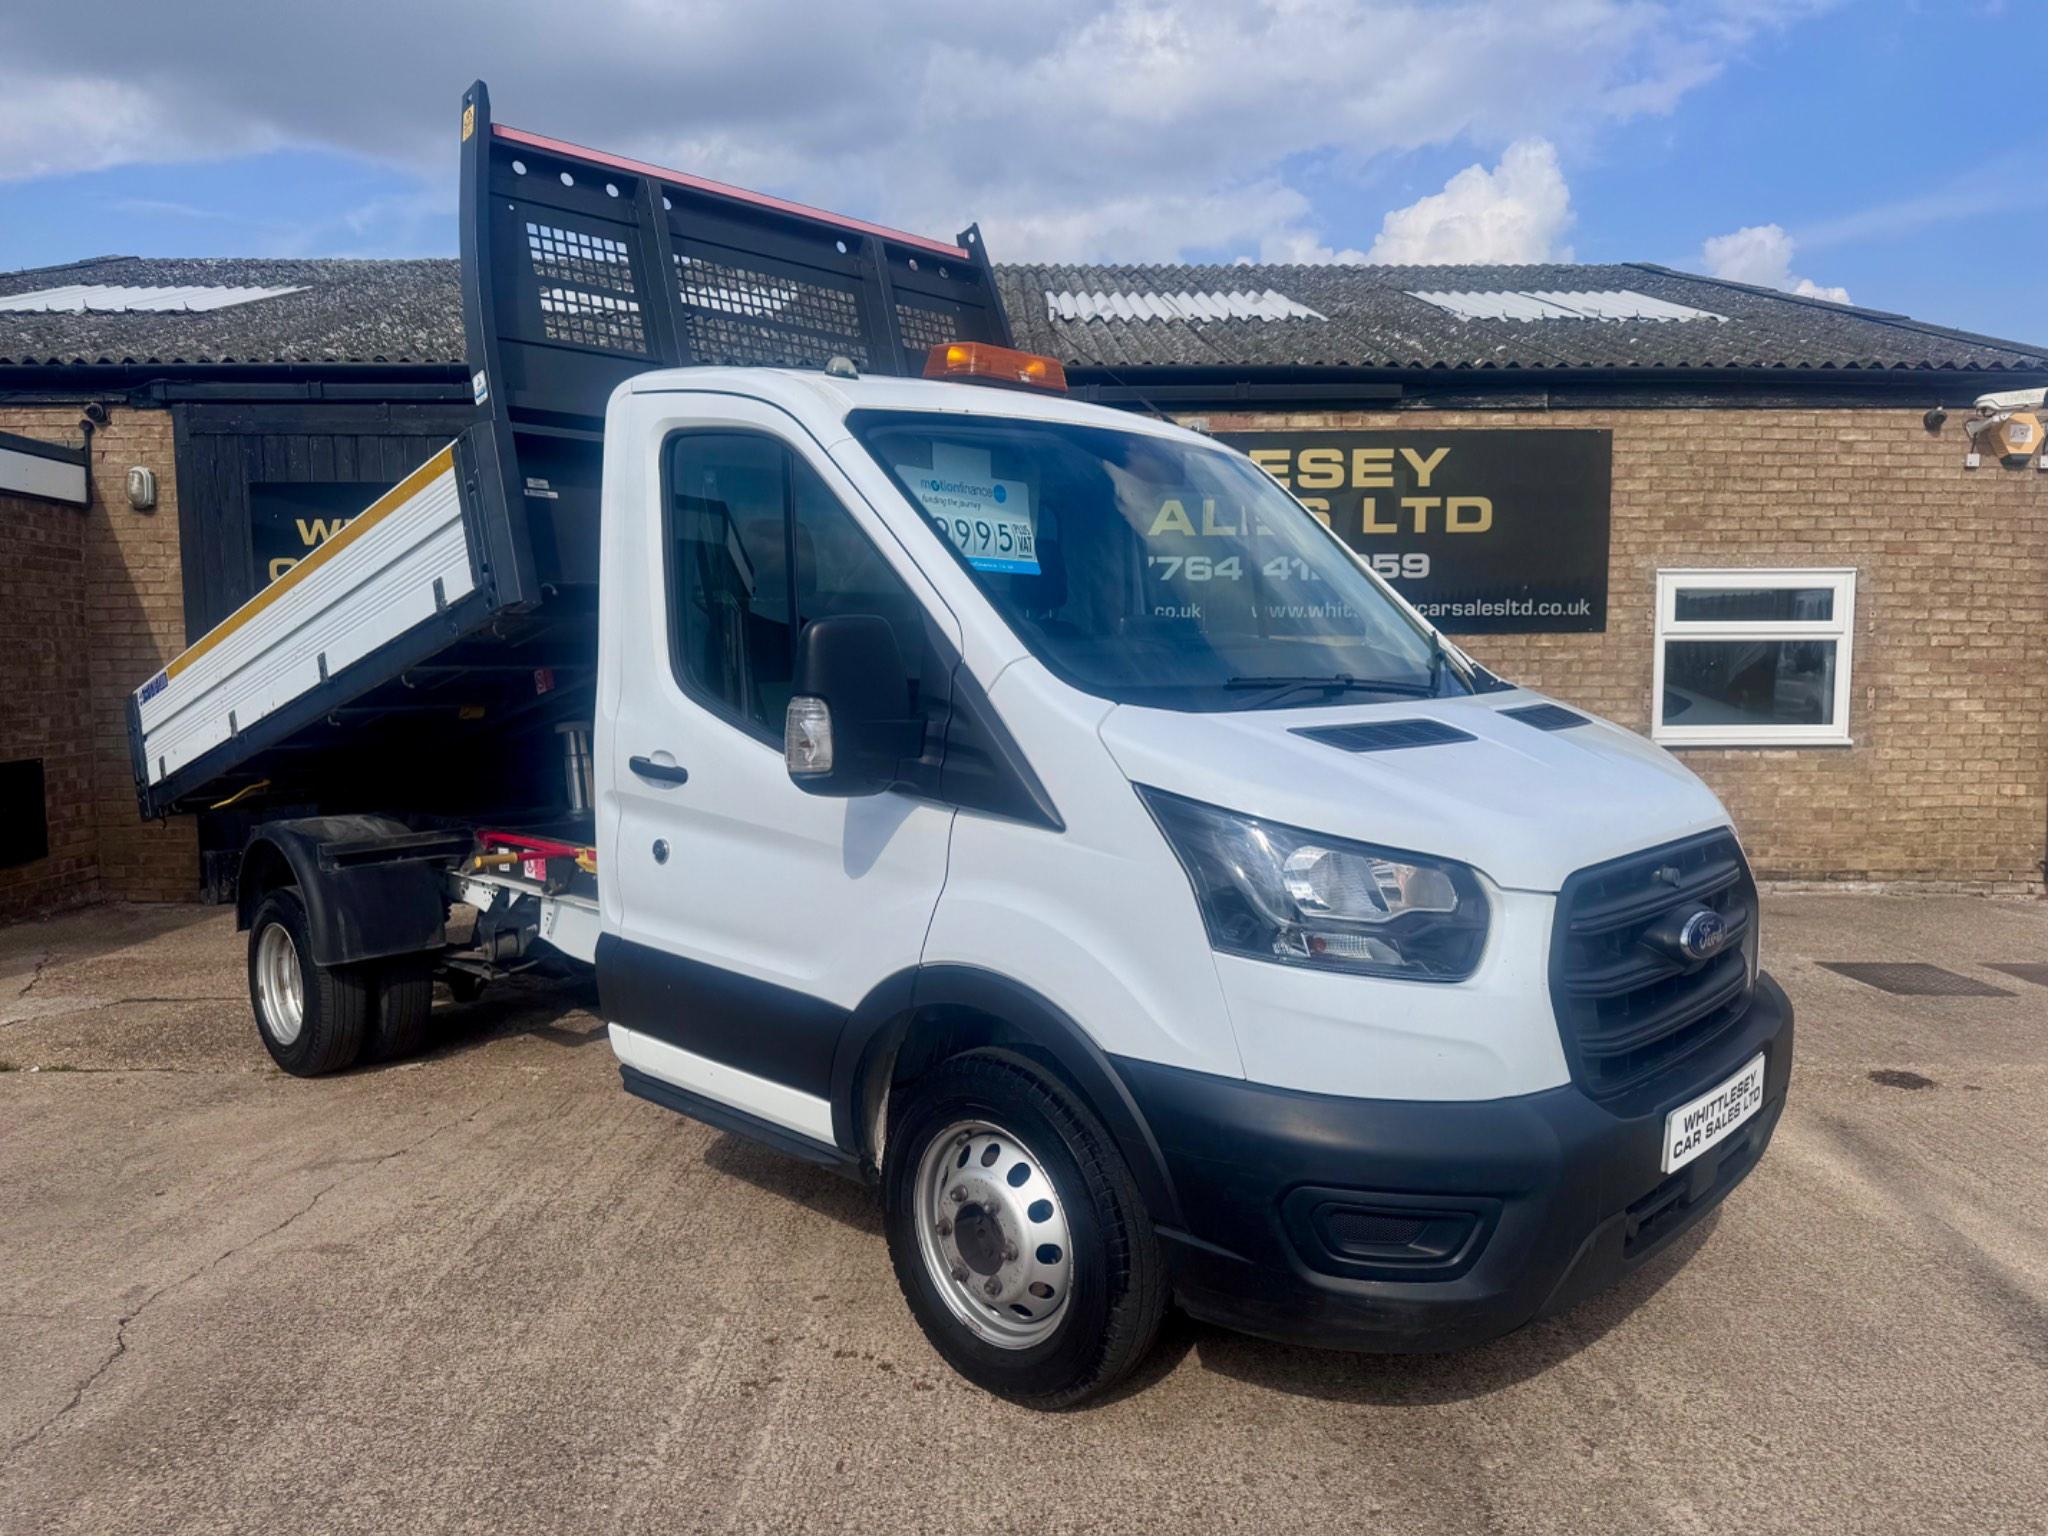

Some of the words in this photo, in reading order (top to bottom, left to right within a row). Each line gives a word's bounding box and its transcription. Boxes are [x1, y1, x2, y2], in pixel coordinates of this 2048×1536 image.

[920, 479, 993, 498] motionfinance
[1363, 496, 1493, 534] LTD
[1017, 535, 1032, 553] VAT
[1148, 556, 1243, 581] 764
[1699, 919, 1723, 950] Ford
[1684, 1069, 1758, 1133] WHITTLESEY
[1673, 1128, 1702, 1159] CAR
[1705, 1102, 1741, 1139] SALES
[1743, 1085, 1760, 1111] LTD
